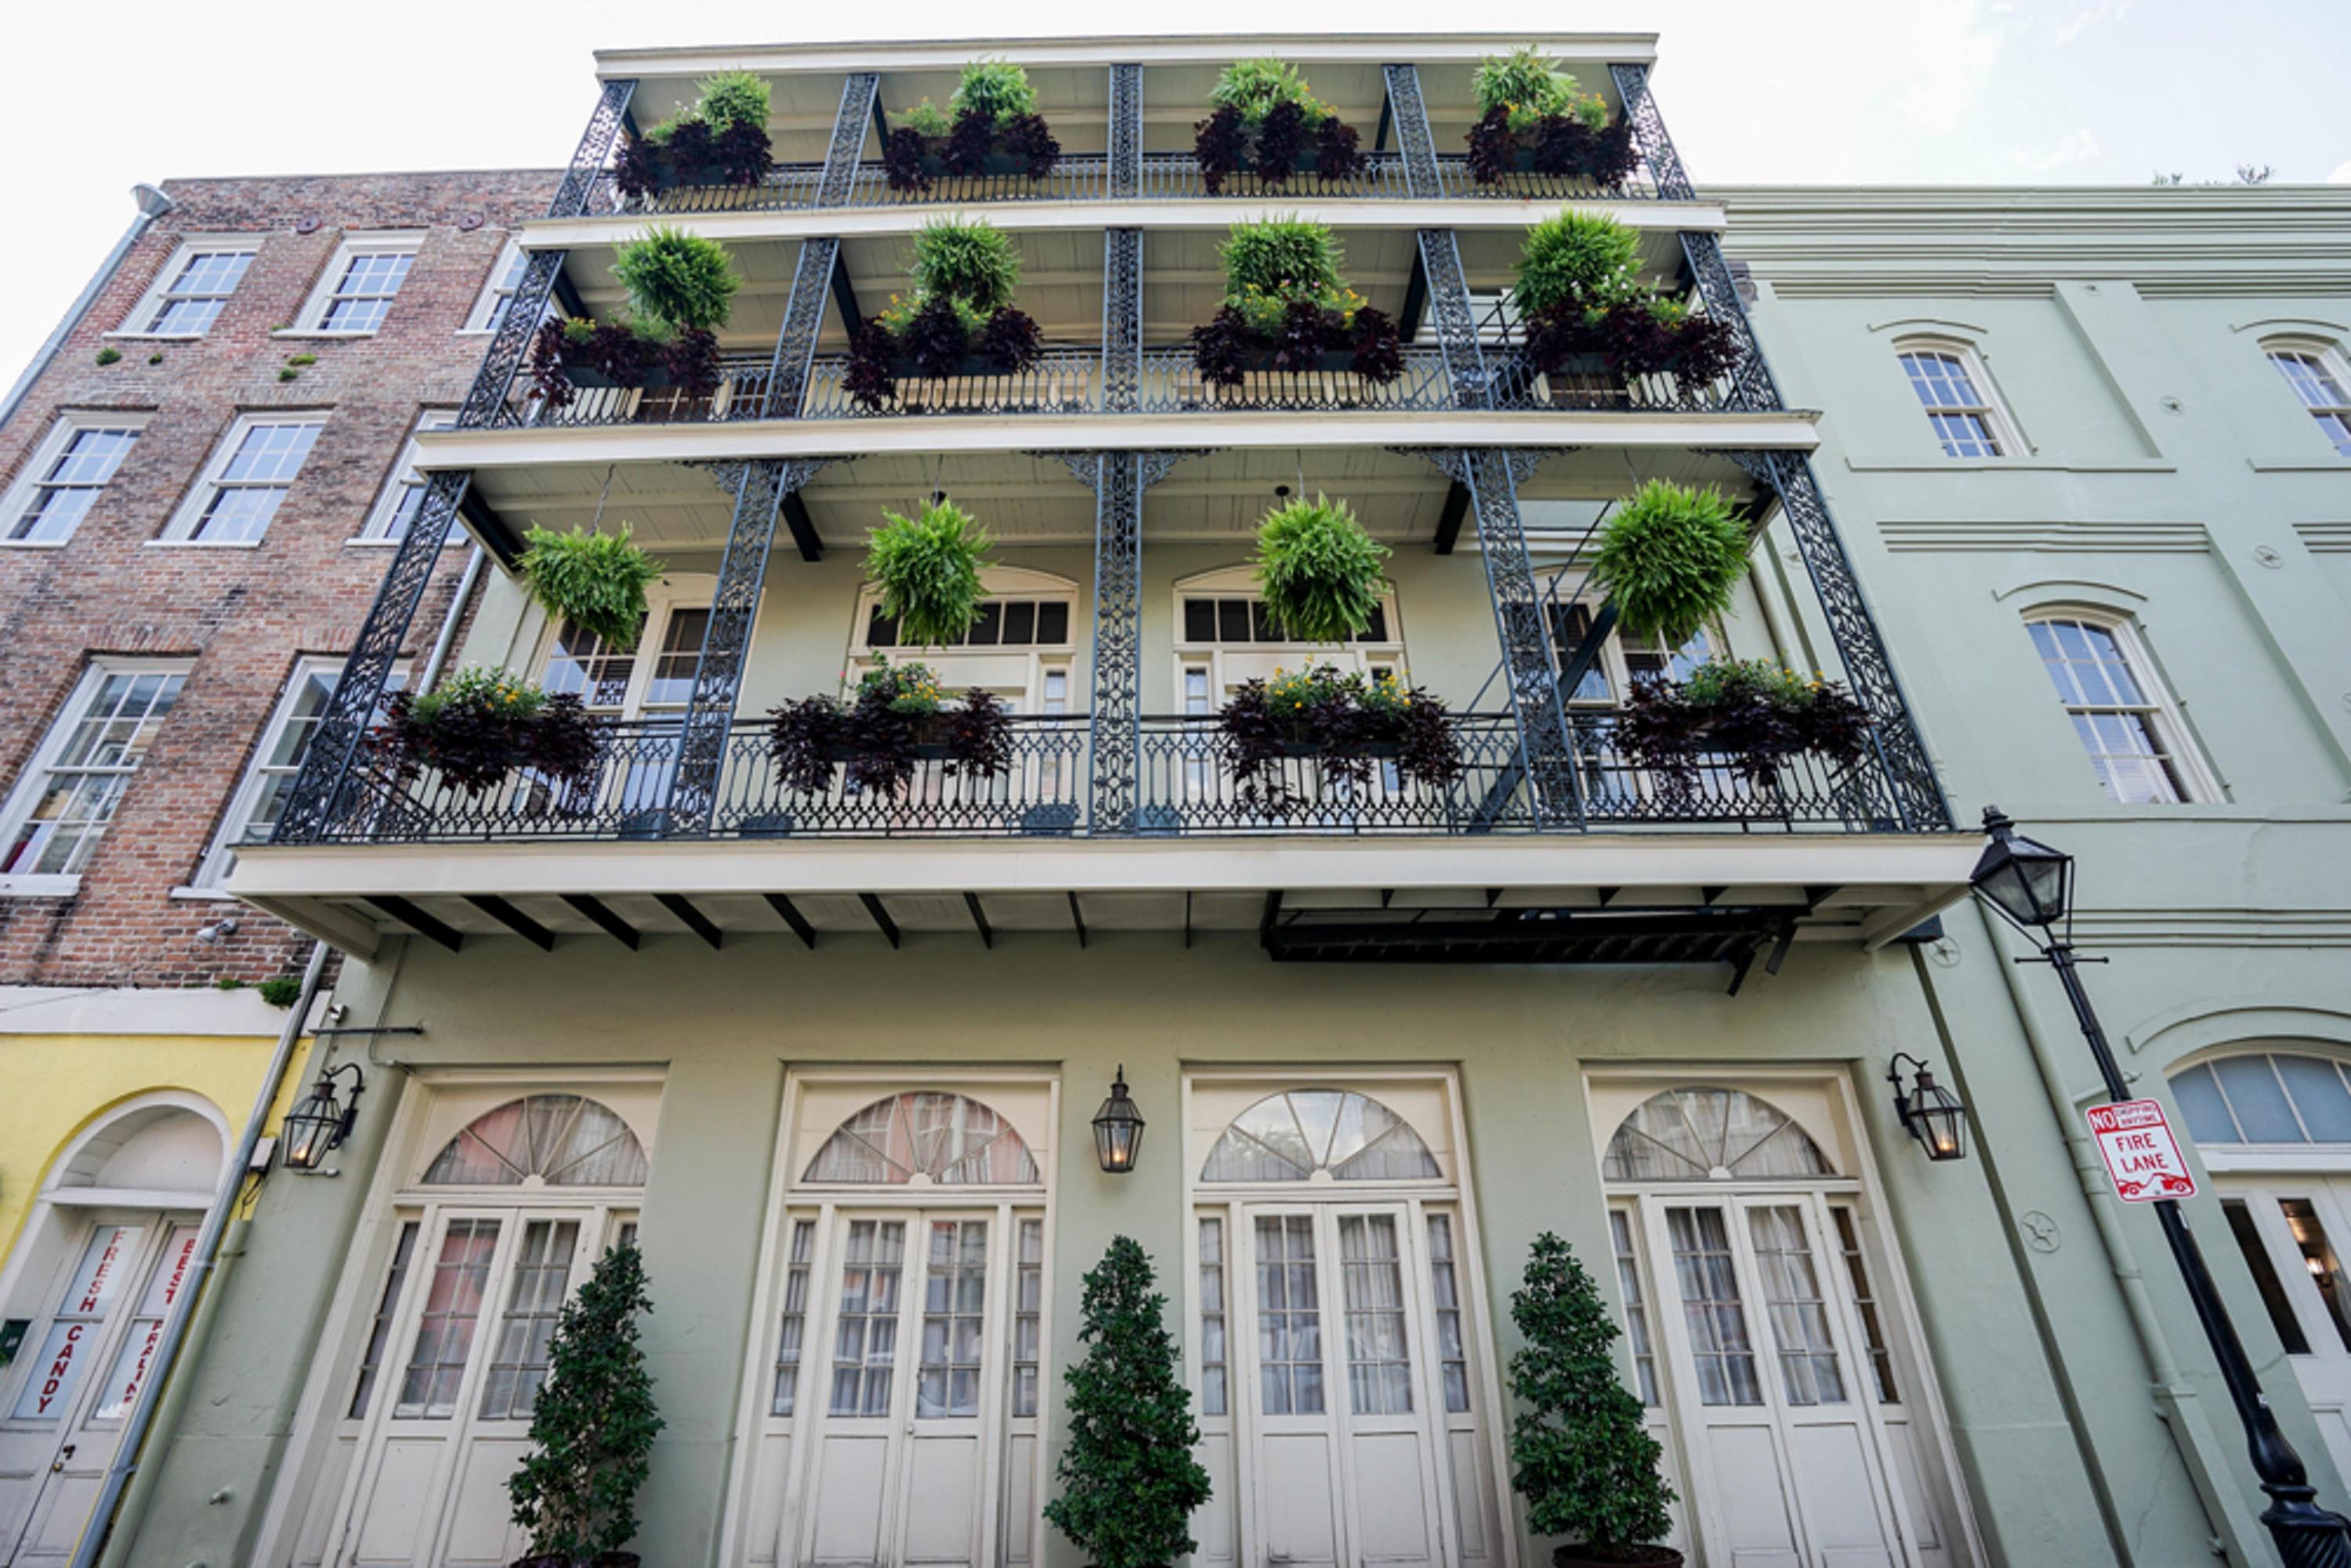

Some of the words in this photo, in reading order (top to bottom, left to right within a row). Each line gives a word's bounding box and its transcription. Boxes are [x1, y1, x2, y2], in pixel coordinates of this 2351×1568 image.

[2090, 1111, 2116, 1129] NO
[2115, 1132, 2157, 1152] FIRE
[2120, 1153, 2168, 1173] LANE
[79, 1229, 126, 1313] FRESH
[37, 1325, 84, 1414] CANDY
[118, 1319, 164, 1417] PRALIN
